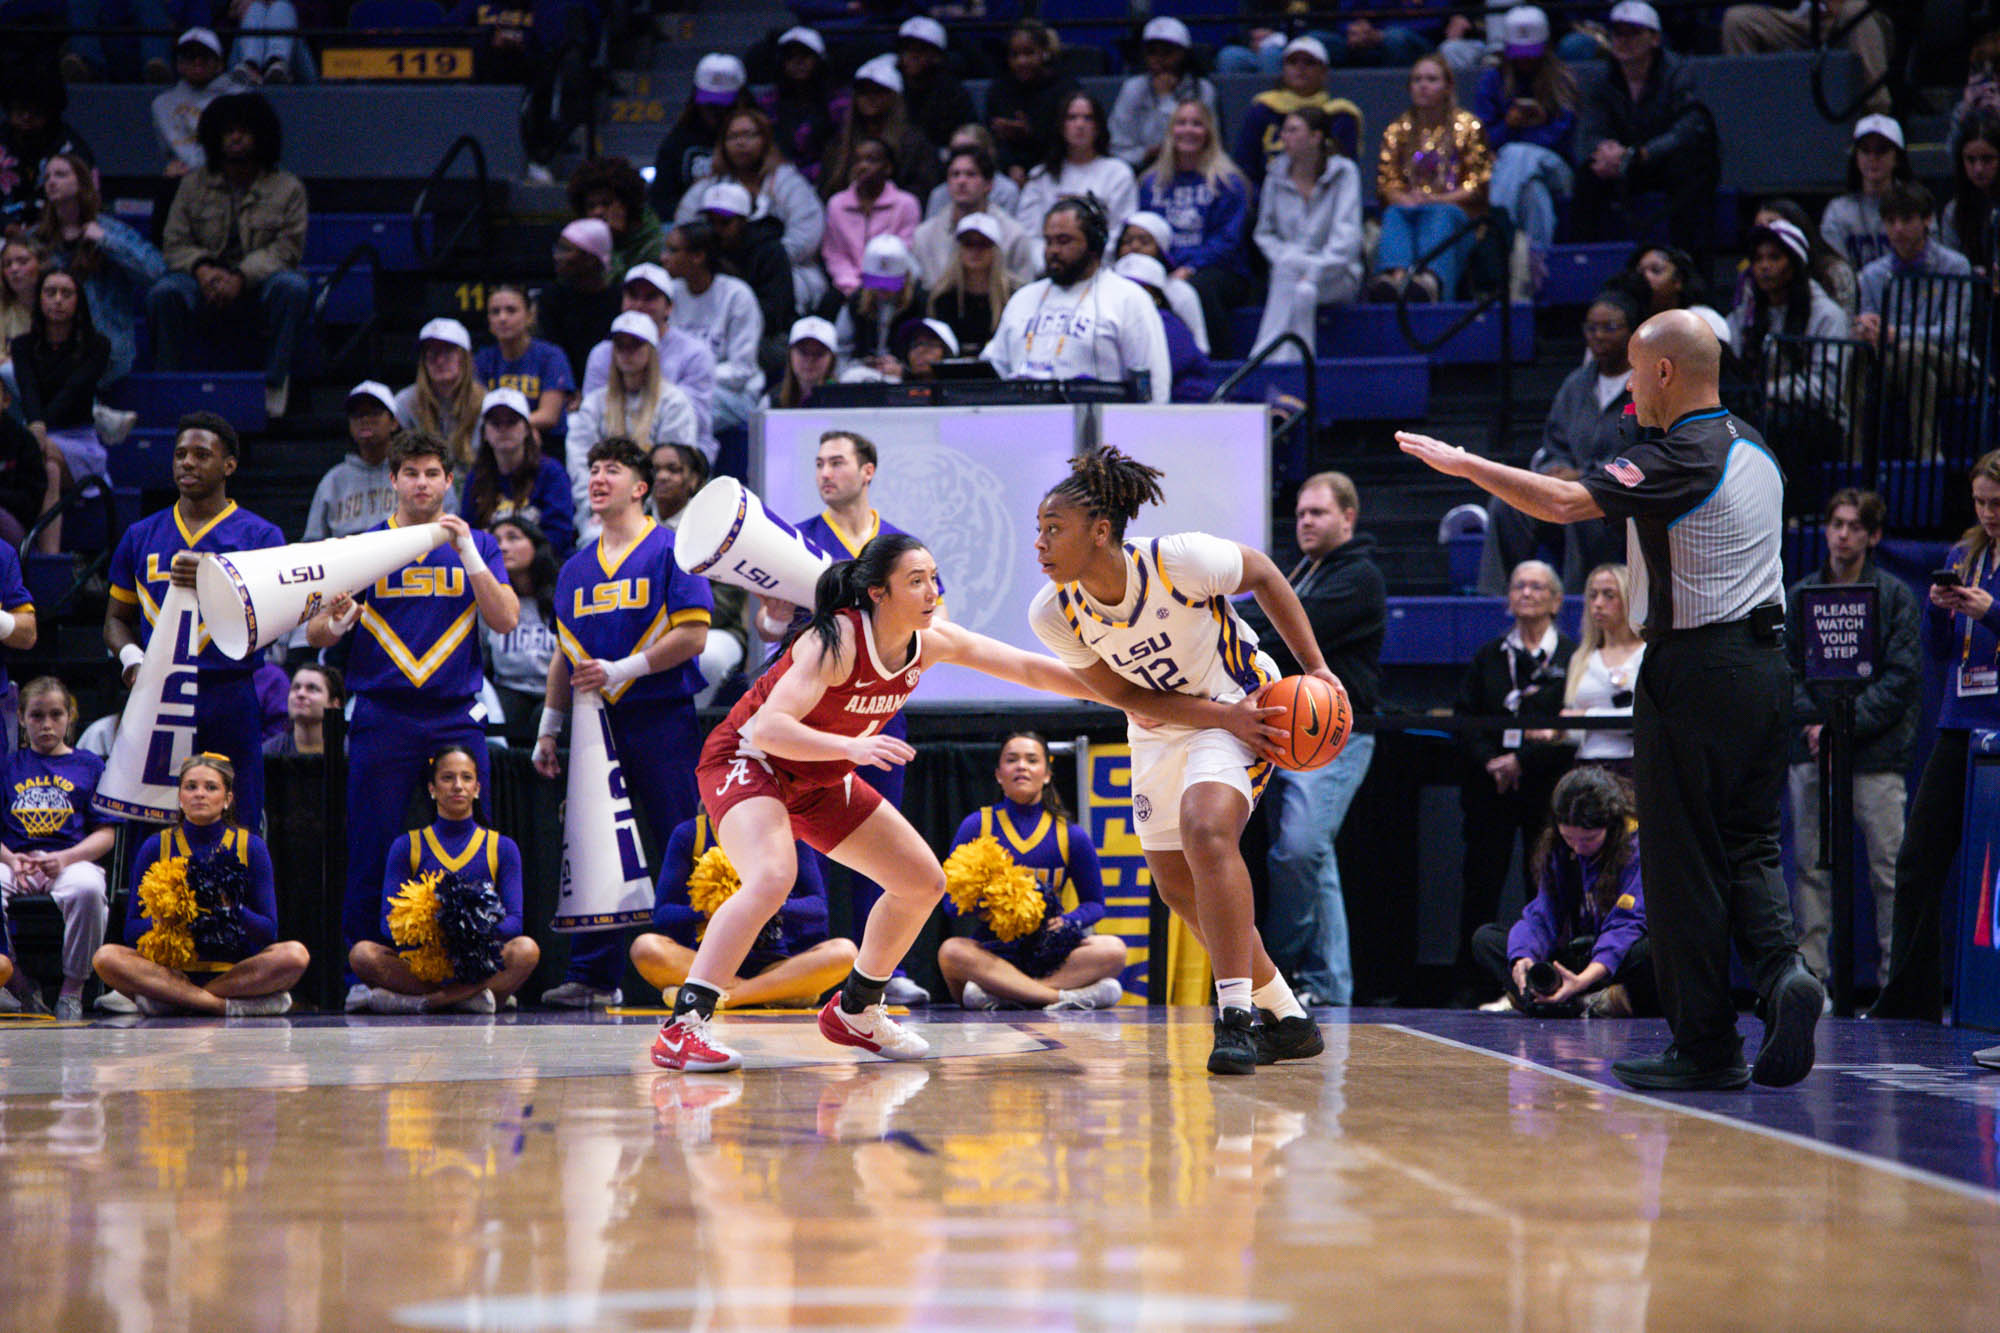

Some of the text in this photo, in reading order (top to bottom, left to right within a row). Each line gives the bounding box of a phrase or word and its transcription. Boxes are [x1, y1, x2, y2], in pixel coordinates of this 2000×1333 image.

[388, 53, 458, 74] 119
[455, 283, 484, 311] 11
[279, 564, 325, 585] LSU
[375, 566, 465, 599] LSU
[733, 559, 780, 590] LSU
[573, 577, 650, 619] LSU
[1813, 603, 1866, 616] PLEASE
[1816, 618, 1864, 630] WATCH
[1820, 632, 1858, 644] YOUR
[1111, 631, 1172, 667] LSU
[1823, 646, 1858, 659] STEP
[1130, 657, 1189, 692] 12
[843, 693, 909, 714] ALABAM
[14, 774, 75, 794] BALL KID
